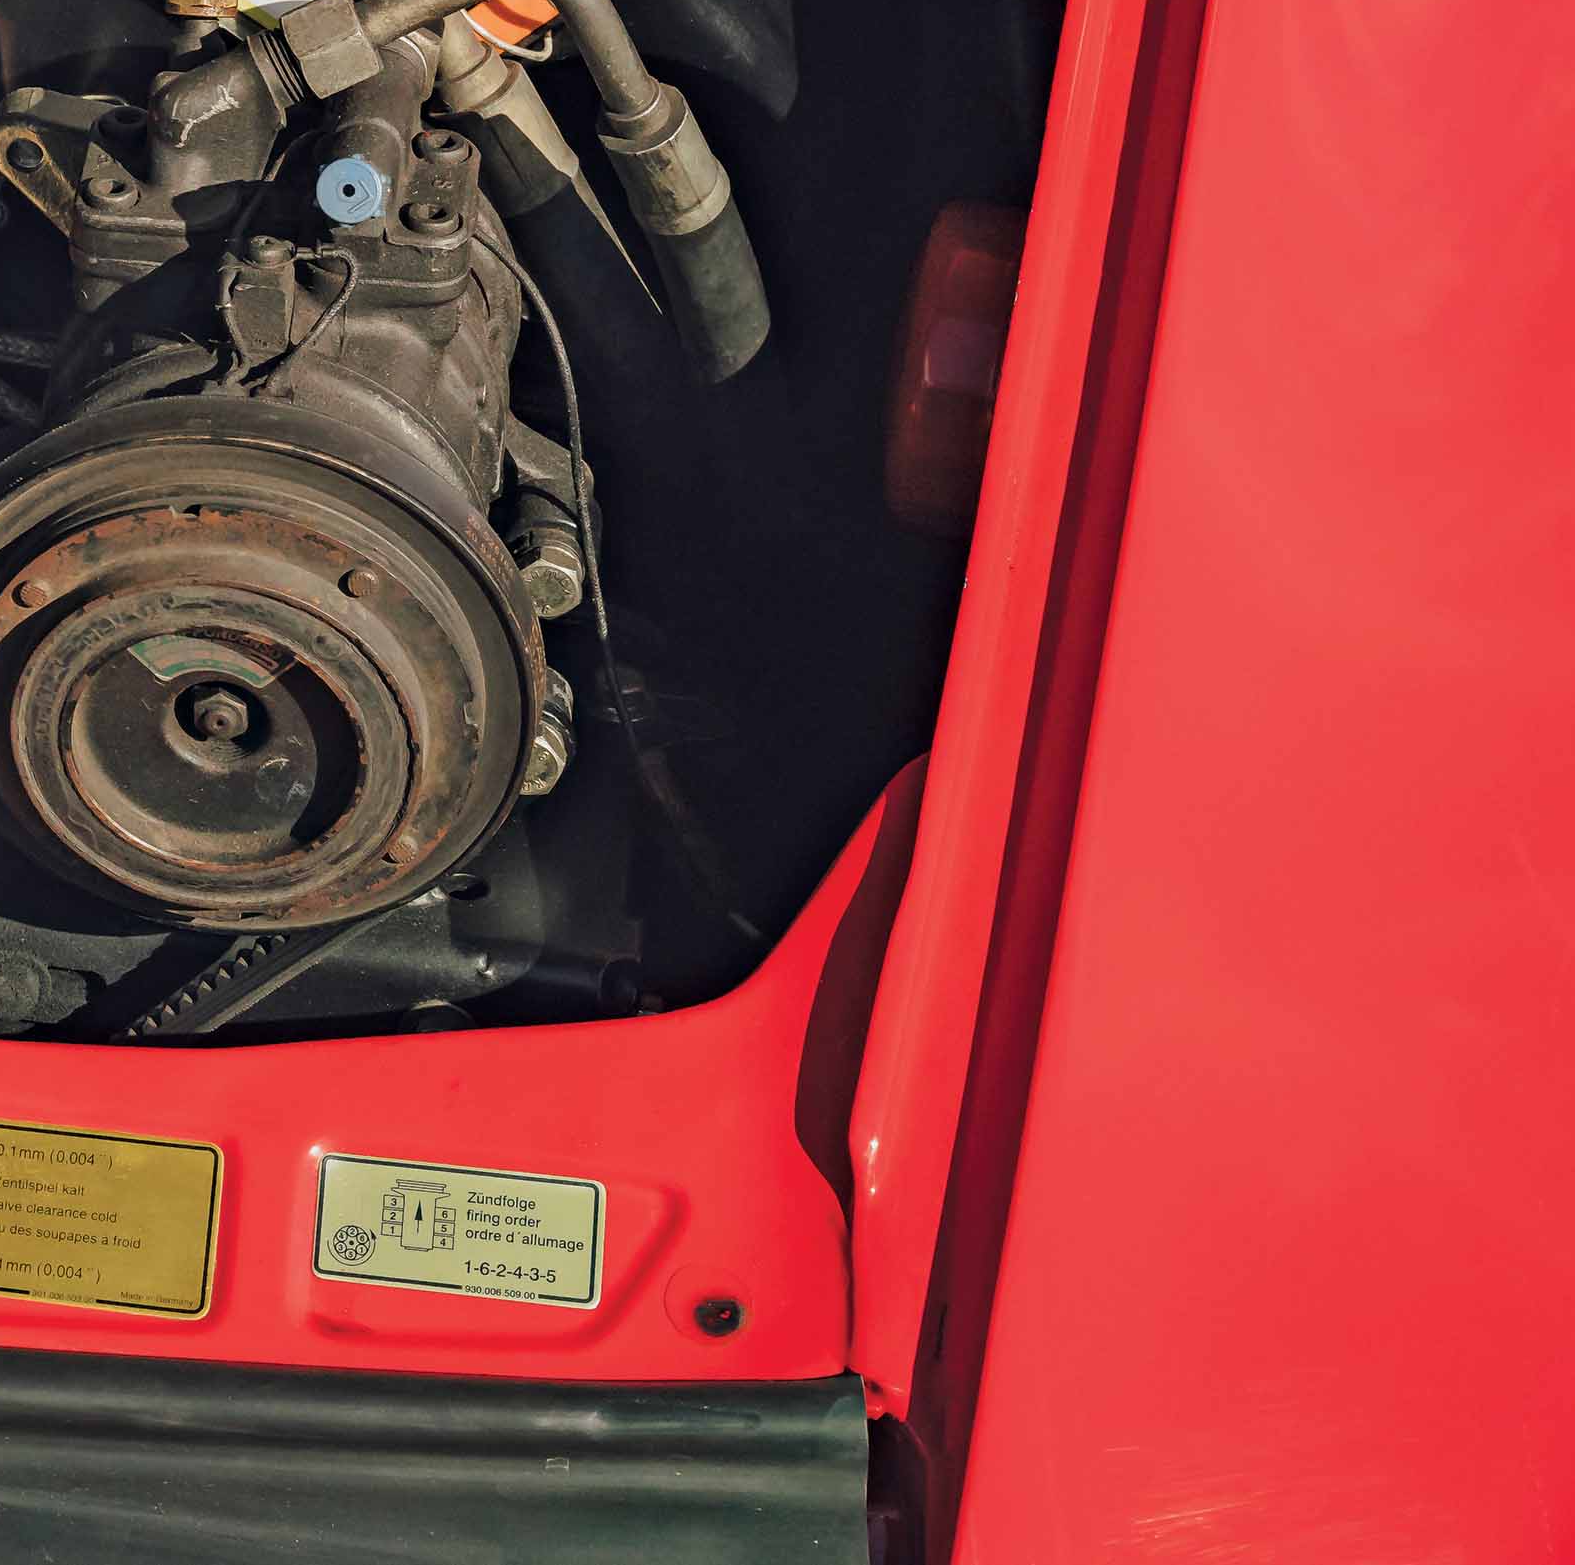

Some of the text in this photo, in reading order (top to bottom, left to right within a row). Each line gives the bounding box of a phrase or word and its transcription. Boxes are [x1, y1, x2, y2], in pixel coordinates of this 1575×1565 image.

[62, 1183, 84, 1197] kalt
[391, 1198, 397, 1206] 3
[467, 1192, 536, 1211] Zündfolge
[27, 1203, 87, 1220] clearance
[91, 1211, 117, 1224] cold
[390, 1212, 396, 1220] 2
[467, 1209, 541, 1228] firing order
[10, 1224, 32, 1236] des
[36, 1228, 97, 1244] soupapes
[113, 1235, 141, 1249] froid
[440, 1238, 446, 1246] 4
[466, 1229, 501, 1241] ordre
[464, 1260, 556, 1283] 1-6-2-4-3-5
[465, 1285, 535, 1300] 930.006.509.00
